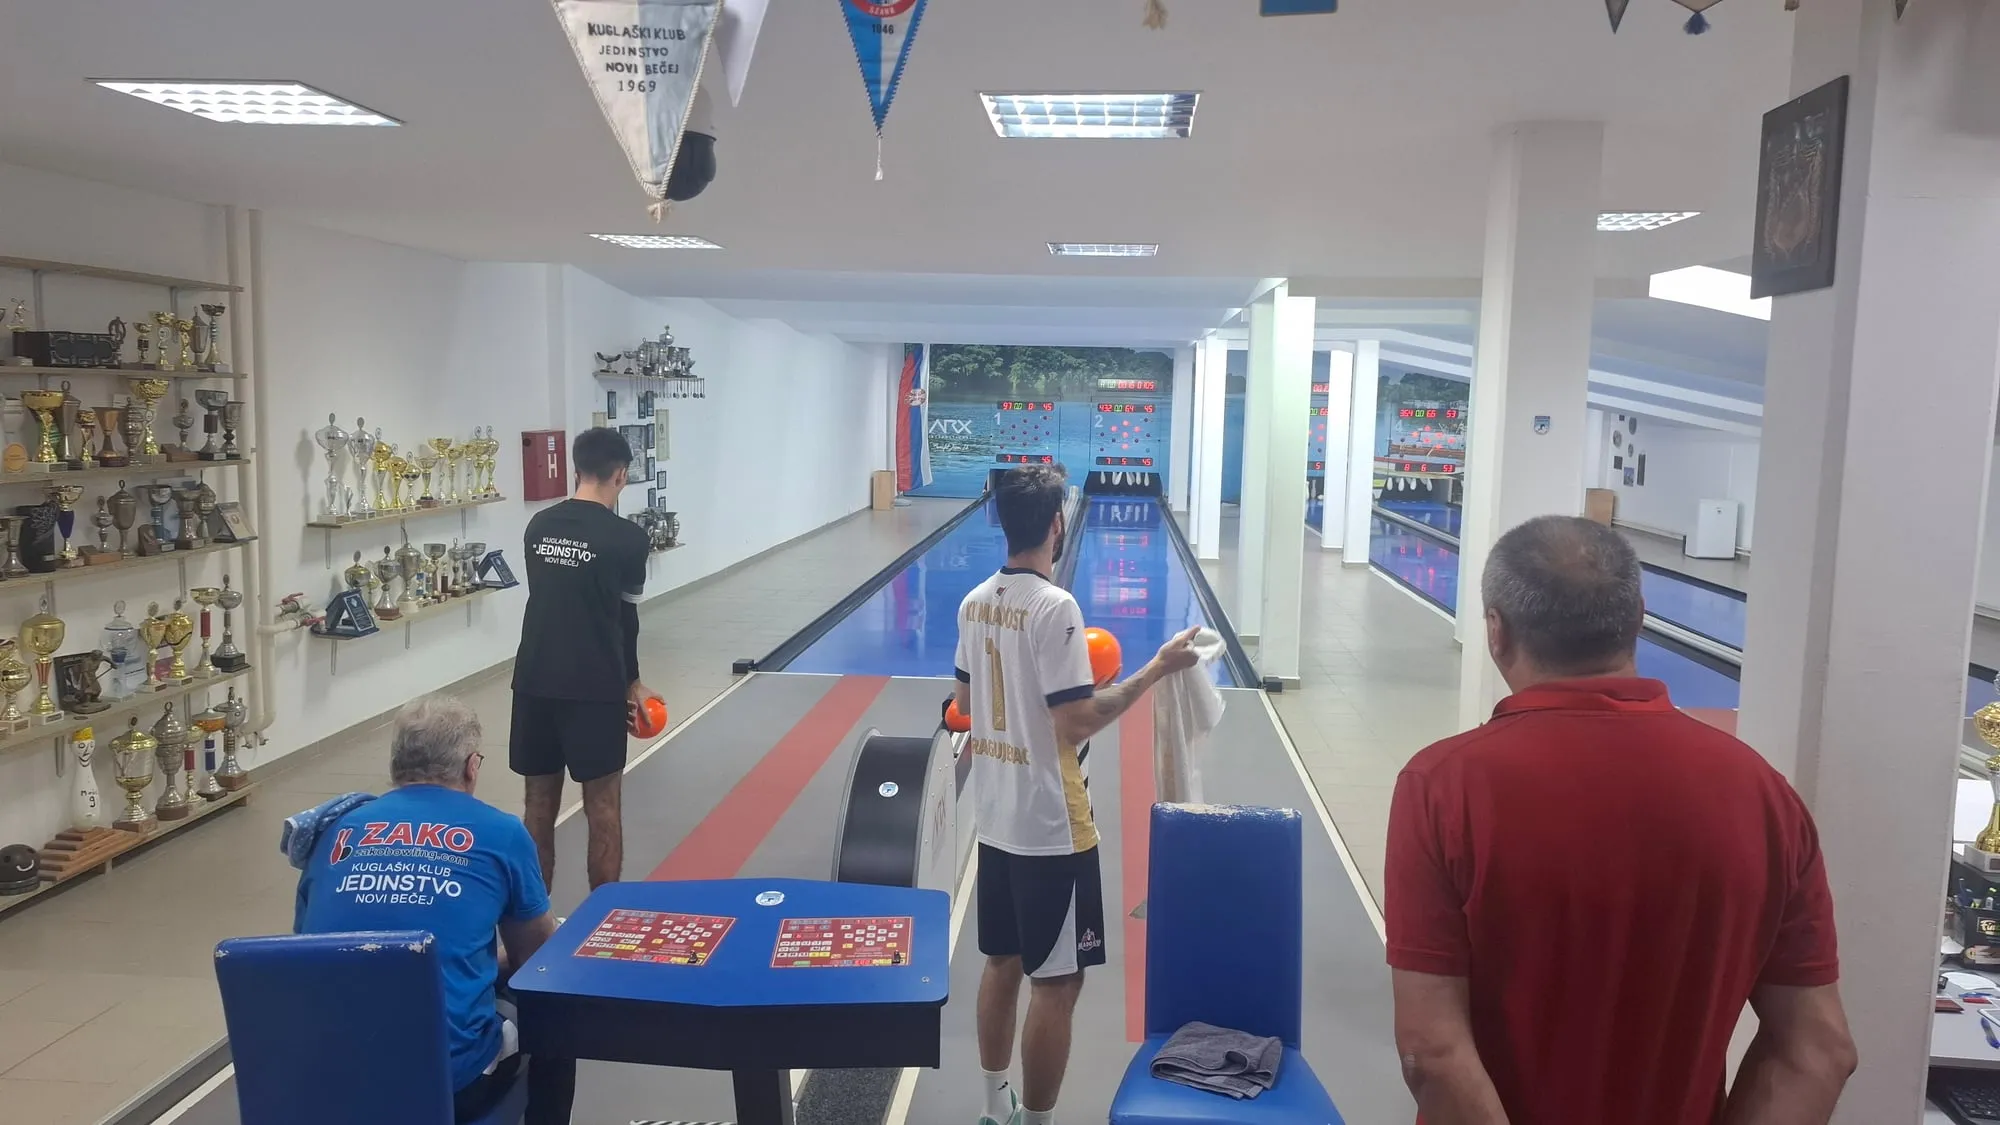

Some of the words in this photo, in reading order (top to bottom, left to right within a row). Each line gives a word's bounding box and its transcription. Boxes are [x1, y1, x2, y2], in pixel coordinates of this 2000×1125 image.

[587, 22, 651, 39] KUGLAŠKI
[654, 27, 686, 41] KLUB
[598, 45, 669, 58] JEDINSTVO
[606, 62, 638, 74] NOVI
[618, 80, 657, 93] 1969
[1095, 415, 1104, 428] 2
[548, 453, 557, 478] H
[542, 537, 572, 546] KUGLAŠKI
[572, 541, 588, 549] KLUB
[985, 637, 1006, 731] 1
[358, 822, 474, 853] ZAKO
[351, 861, 415, 873] KUGLAŠKI
[417, 864, 452, 877] KLUB
[335, 874, 462, 898] JEDINSTVO
[355, 893, 388, 904] NOVI
[390, 892, 434, 906] BEČEJ
